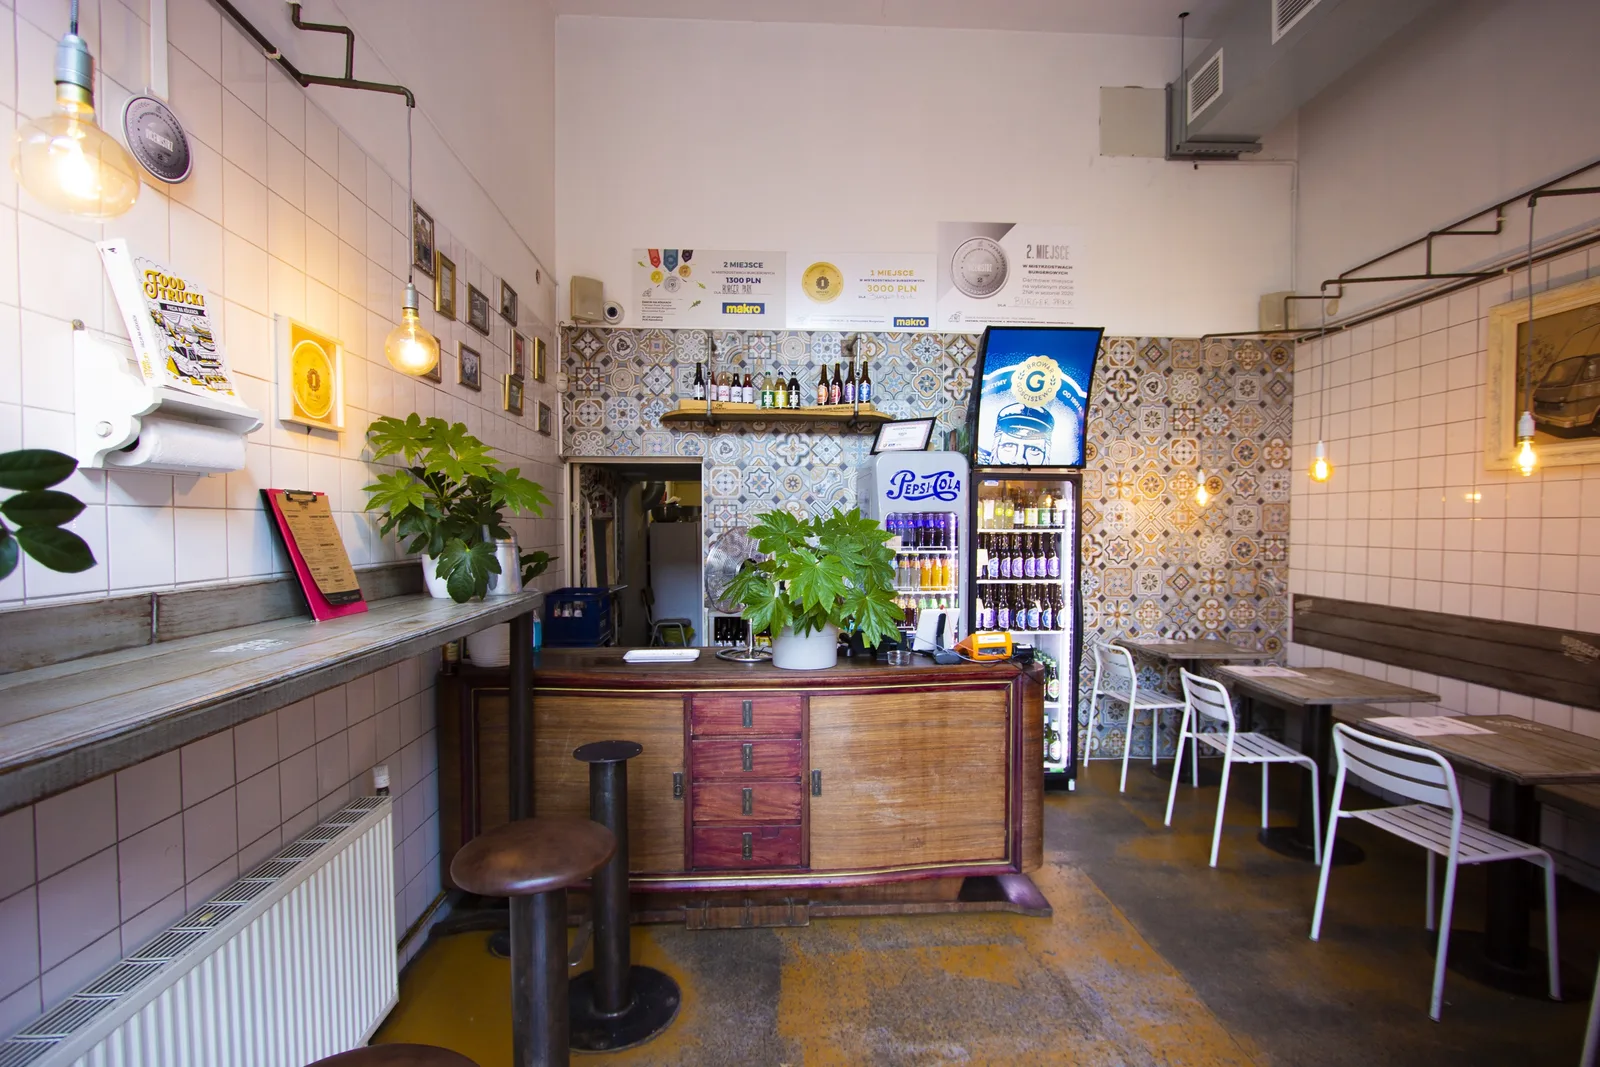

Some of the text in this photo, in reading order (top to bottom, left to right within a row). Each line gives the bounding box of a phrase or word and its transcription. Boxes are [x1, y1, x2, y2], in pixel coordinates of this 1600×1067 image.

[1026, 244, 1070, 260] 2. MIEJSCE
[726, 304, 761, 314] makro
[896, 318, 926, 326] makro
[1026, 361, 1055, 374] BROWAR
[1026, 370, 1046, 392] G
[1062, 390, 1071, 399] OD
